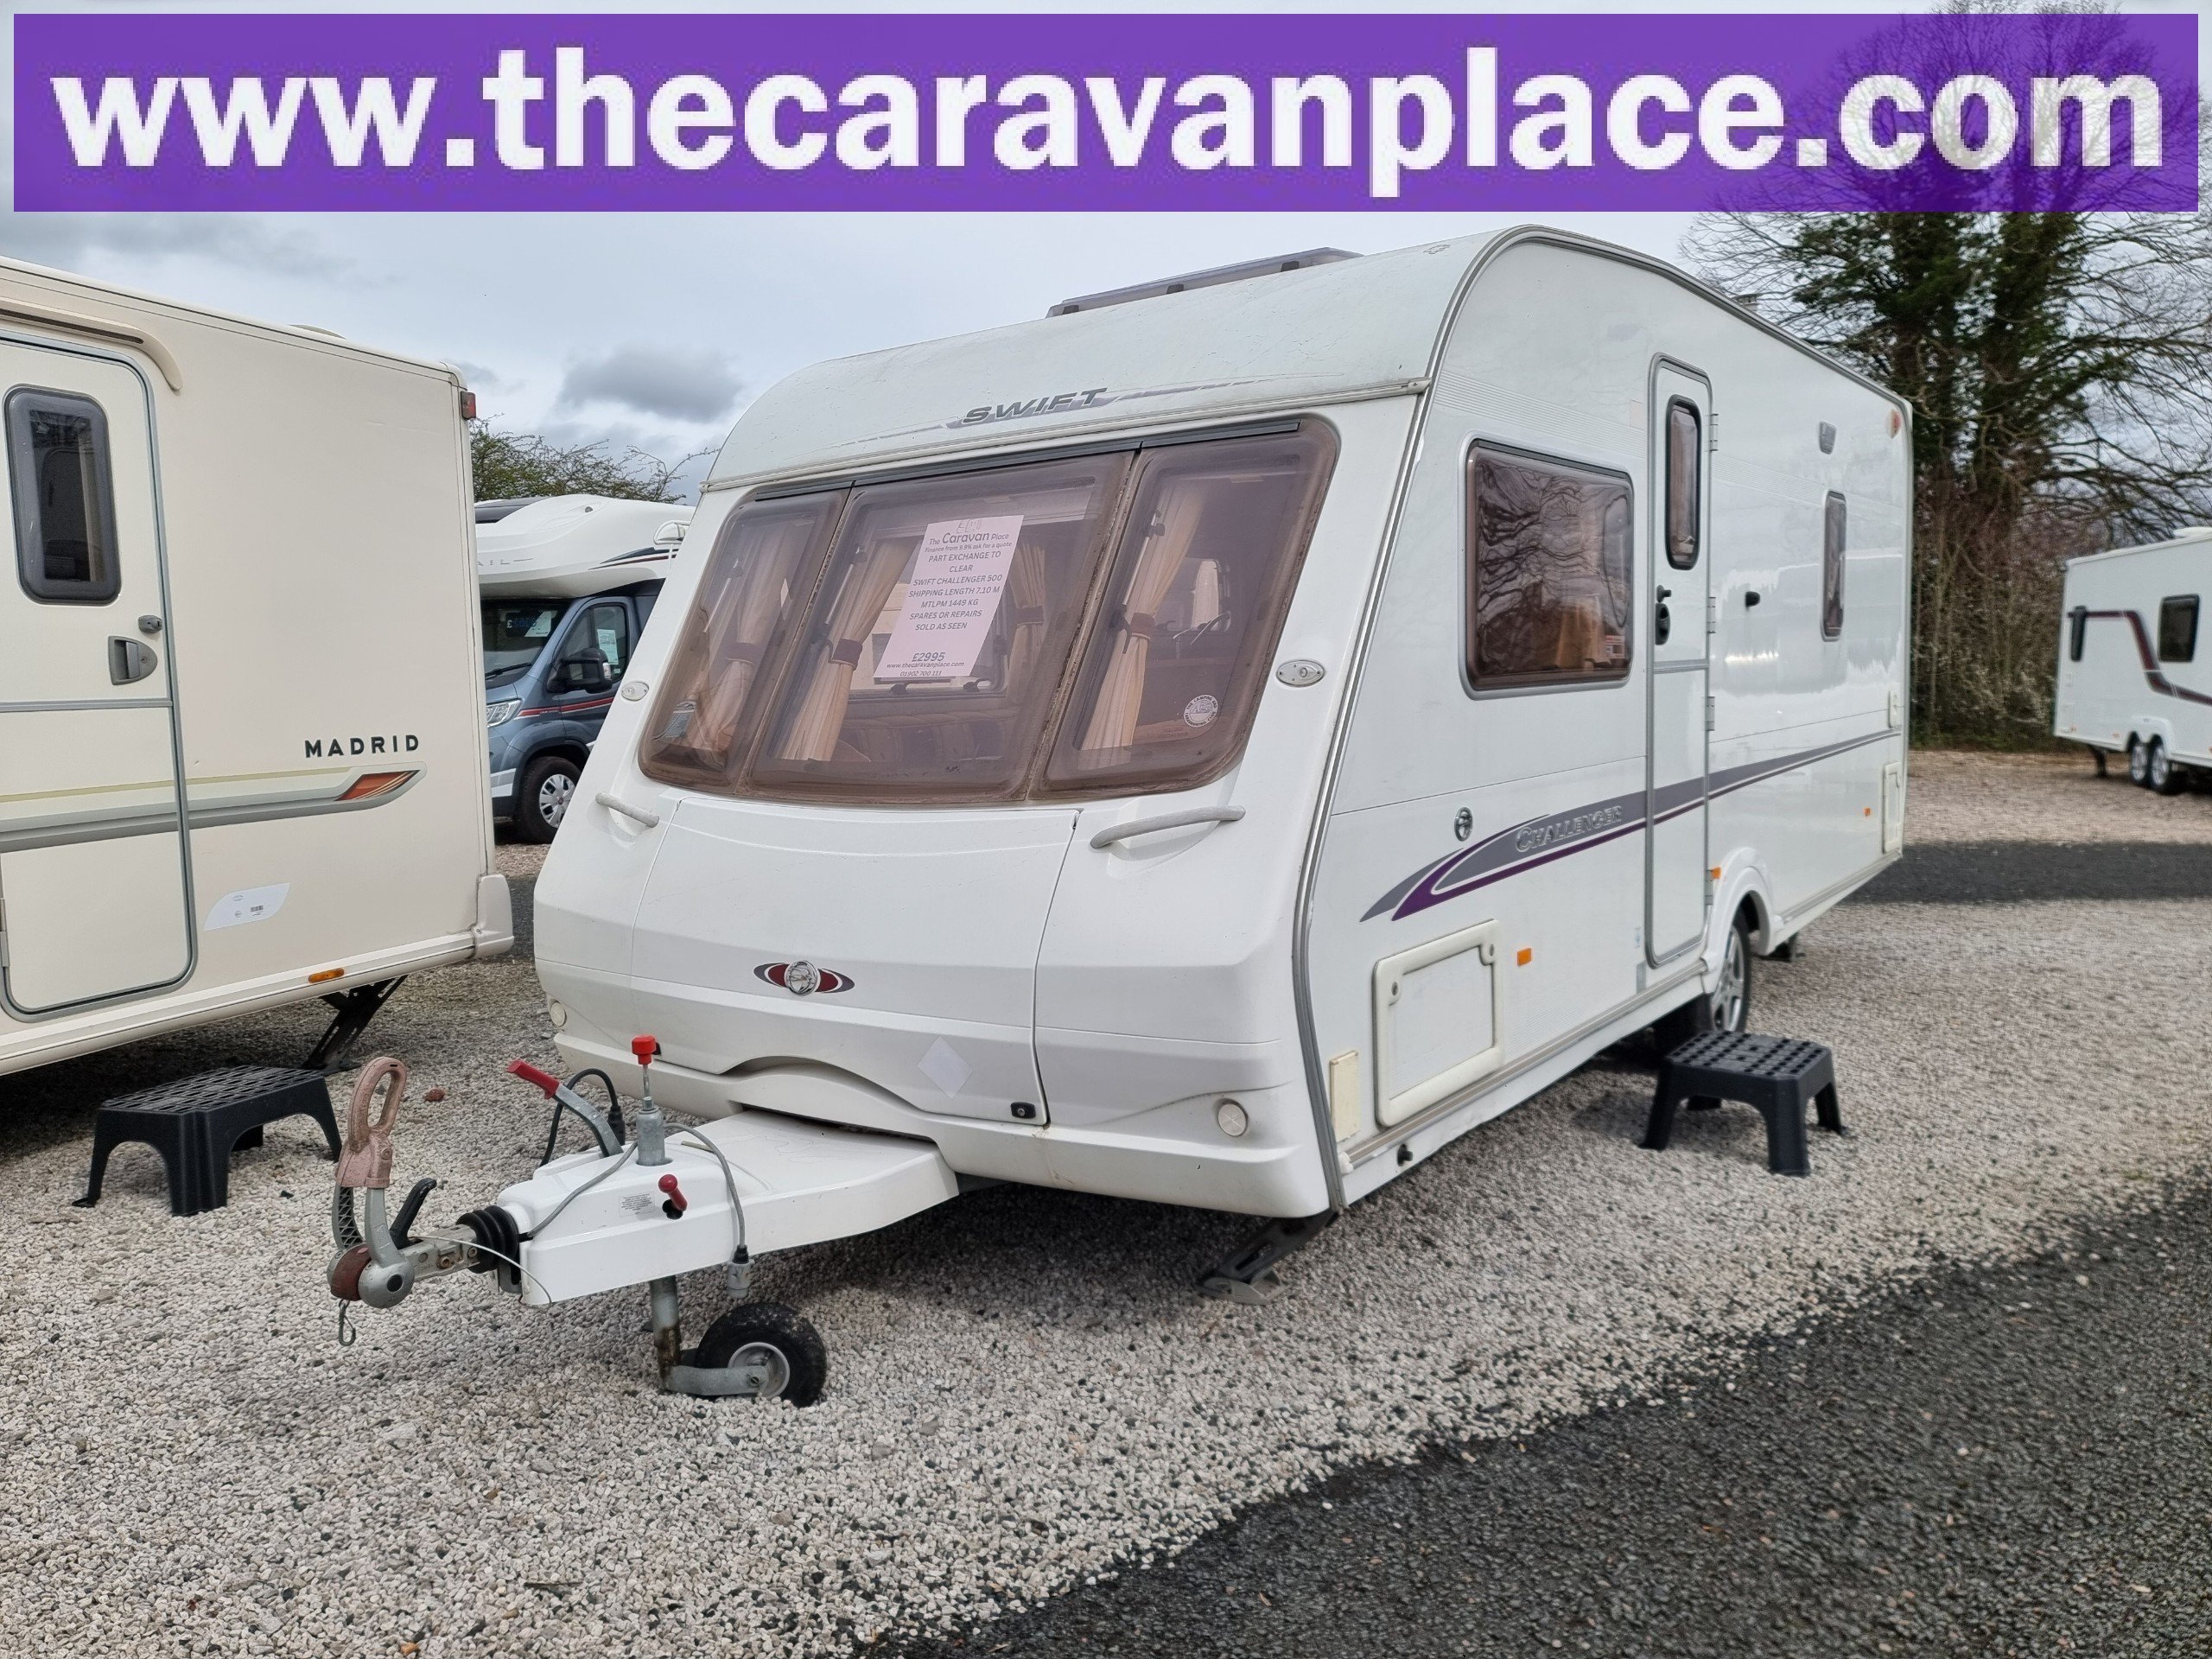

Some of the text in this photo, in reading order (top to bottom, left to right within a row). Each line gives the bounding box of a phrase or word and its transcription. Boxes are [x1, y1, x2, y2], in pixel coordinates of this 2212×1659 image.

[963, 387, 1109, 423] SWIFT
[942, 532, 989, 543] Caravan
[948, 552, 990, 561] EXCHANGE
[936, 575, 986, 584] CHALLENGER
[908, 589, 943, 597] SHIPPING
[945, 587, 975, 596] LENGTH
[911, 652, 945, 662] £2995
[305, 734, 420, 759] MADRID
[1515, 805, 1623, 852] CHALLENGER
